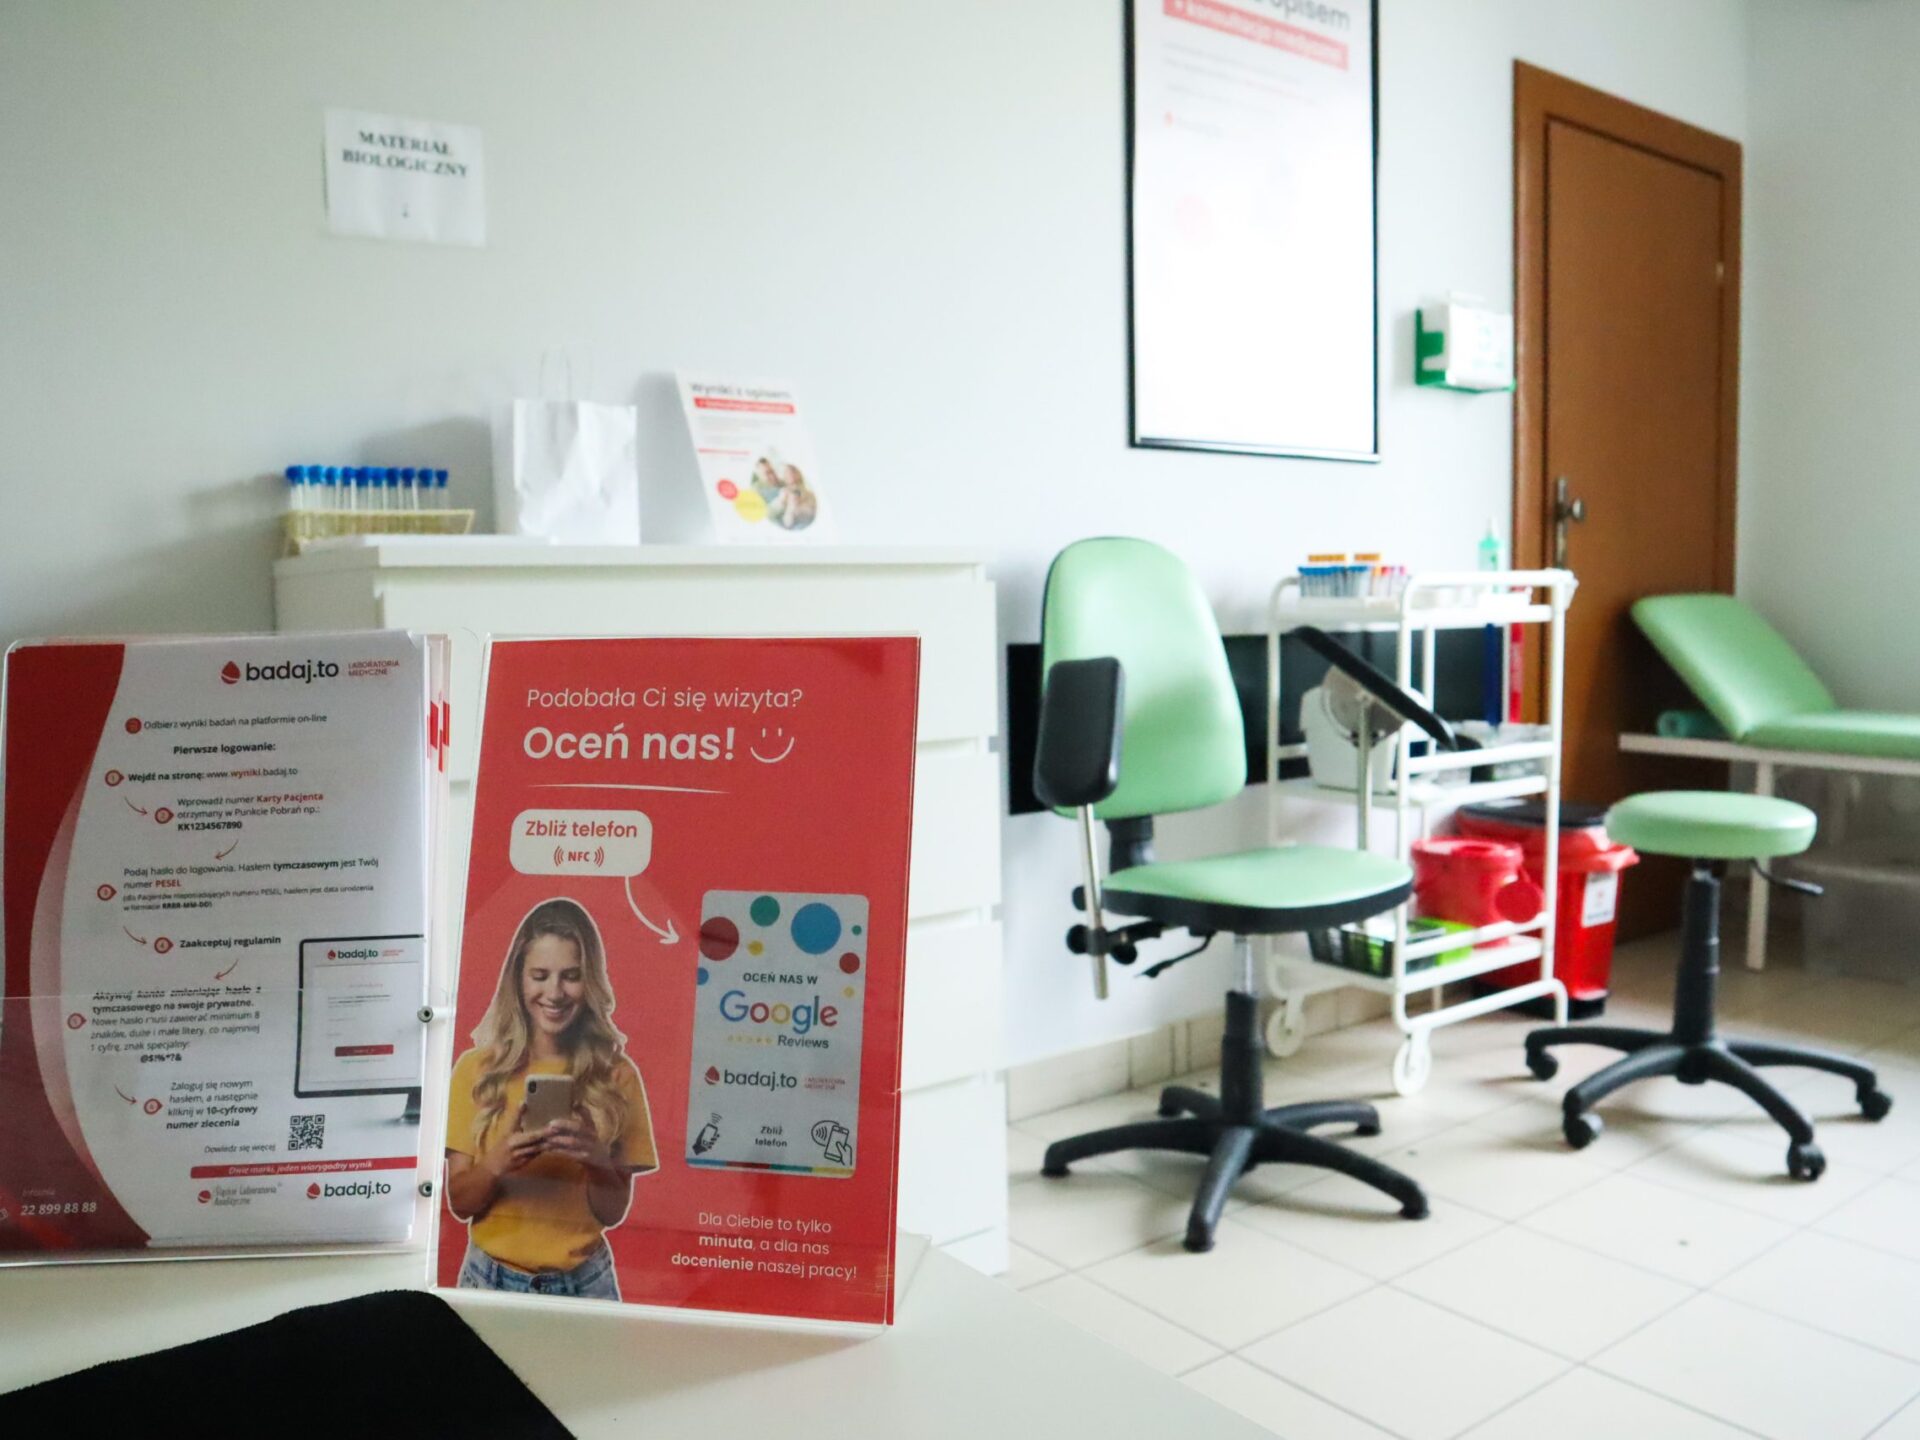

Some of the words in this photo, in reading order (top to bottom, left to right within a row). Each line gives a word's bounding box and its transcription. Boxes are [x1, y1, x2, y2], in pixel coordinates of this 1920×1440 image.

[246, 659, 339, 684] badaj.to
[526, 687, 636, 709] Podobała
[643, 687, 667, 708] Ci
[673, 687, 707, 711] się
[714, 688, 803, 714] wizyta?
[143, 719, 178, 730] Odbierz
[180, 718, 206, 730] wyniki
[209, 716, 236, 727] badań
[238, 718, 249, 726] na
[251, 715, 296, 728] platformie
[297, 713, 328, 724] on-line
[523, 722, 629, 760] Oceń
[642, 726, 736, 760] nas!
[173, 744, 218, 755] Pierwsze
[220, 742, 276, 755] logowanie:
[127, 771, 156, 782] Wejdź
[172, 770, 205, 782] stronę:
[177, 796, 224, 808] Wprowadź
[225, 796, 254, 804] numer
[256, 795, 282, 805] Karty
[284, 793, 324, 804] Pacjenta
[177, 810, 223, 820] otrzymany
[234, 807, 268, 817] Punkcie
[270, 806, 302, 816] Pobrań
[177, 821, 242, 832] KK1234567890
[525, 820, 567, 837] Zbliż
[572, 820, 638, 838] telefon
[568, 851, 590, 862] NFC
[124, 868, 148, 878] Podaj
[150, 866, 174, 876] hasło
[176, 866, 188, 875] do
[190, 864, 236, 876] logowania.
[238, 862, 270, 872] Hasłem
[272, 860, 338, 872] tymczasowym
[340, 858, 356, 870] jest
[358, 858, 378, 869] Twój
[124, 880, 152, 889] numer
[156, 879, 182, 888] PESEL
[180, 936, 232, 949] Zaakceptuj
[234, 934, 282, 947] regulamin
[338, 949, 378, 961] badaj.to
[742, 971, 776, 983] OCEŃ
[779, 974, 804, 984] NAS
[807, 975, 818, 985] W
[92, 1002, 162, 1015] tymczasowego
[164, 1002, 176, 1010] na
[178, 1002, 204, 1012] swoje
[720, 990, 838, 1034] Google
[92, 1017, 118, 1026] Nowe
[119, 1015, 144, 1025] hasło
[169, 1012, 208, 1024] zawierać
[210, 1011, 252, 1021] minimum
[254, 1010, 260, 1020] 8
[129, 1027, 152, 1038] duże
[158, 1026, 180, 1036] małe
[208, 1026, 219, 1034] co
[222, 1024, 260, 1036] najmniej
[124, 1041, 144, 1050] znak
[778, 1034, 830, 1049] Reviews
[170, 1082, 204, 1093] Zaloguj
[206, 1080, 218, 1092] się
[220, 1080, 253, 1090] nowym
[724, 1069, 798, 1092] badaj.to
[214, 1092, 258, 1104] następnie
[168, 1106, 194, 1118] kliknij
[196, 1108, 204, 1116] w
[206, 1104, 258, 1118] 10-cyfrowy
[166, 1120, 198, 1130] numer
[200, 1118, 240, 1128] zlecenia
[760, 1125, 783, 1136] Zbliż
[204, 1144, 236, 1154] Dowiedz
[238, 1144, 250, 1153] się
[754, 1136, 788, 1148] telefon
[300, 1162, 347, 1174] wiarygodny
[348, 1160, 372, 1170] wynik
[324, 1181, 392, 1198] badaj.to
[20, 1205, 36, 1216] 22
[38, 1204, 61, 1215] 899
[64, 1202, 79, 1214] 88
[82, 1202, 97, 1213] 88
[698, 1212, 722, 1226] Dla
[726, 1214, 774, 1230] Ciebie
[778, 1215, 792, 1231] to
[796, 1218, 832, 1236] tylko
[698, 1234, 756, 1251] minuta,
[760, 1240, 770, 1250] a
[774, 1238, 798, 1253] dla
[802, 1242, 830, 1255] nas
[671, 1252, 754, 1271] docenienie
[758, 1262, 805, 1278] naszej
[808, 1264, 857, 1282] pracy!
